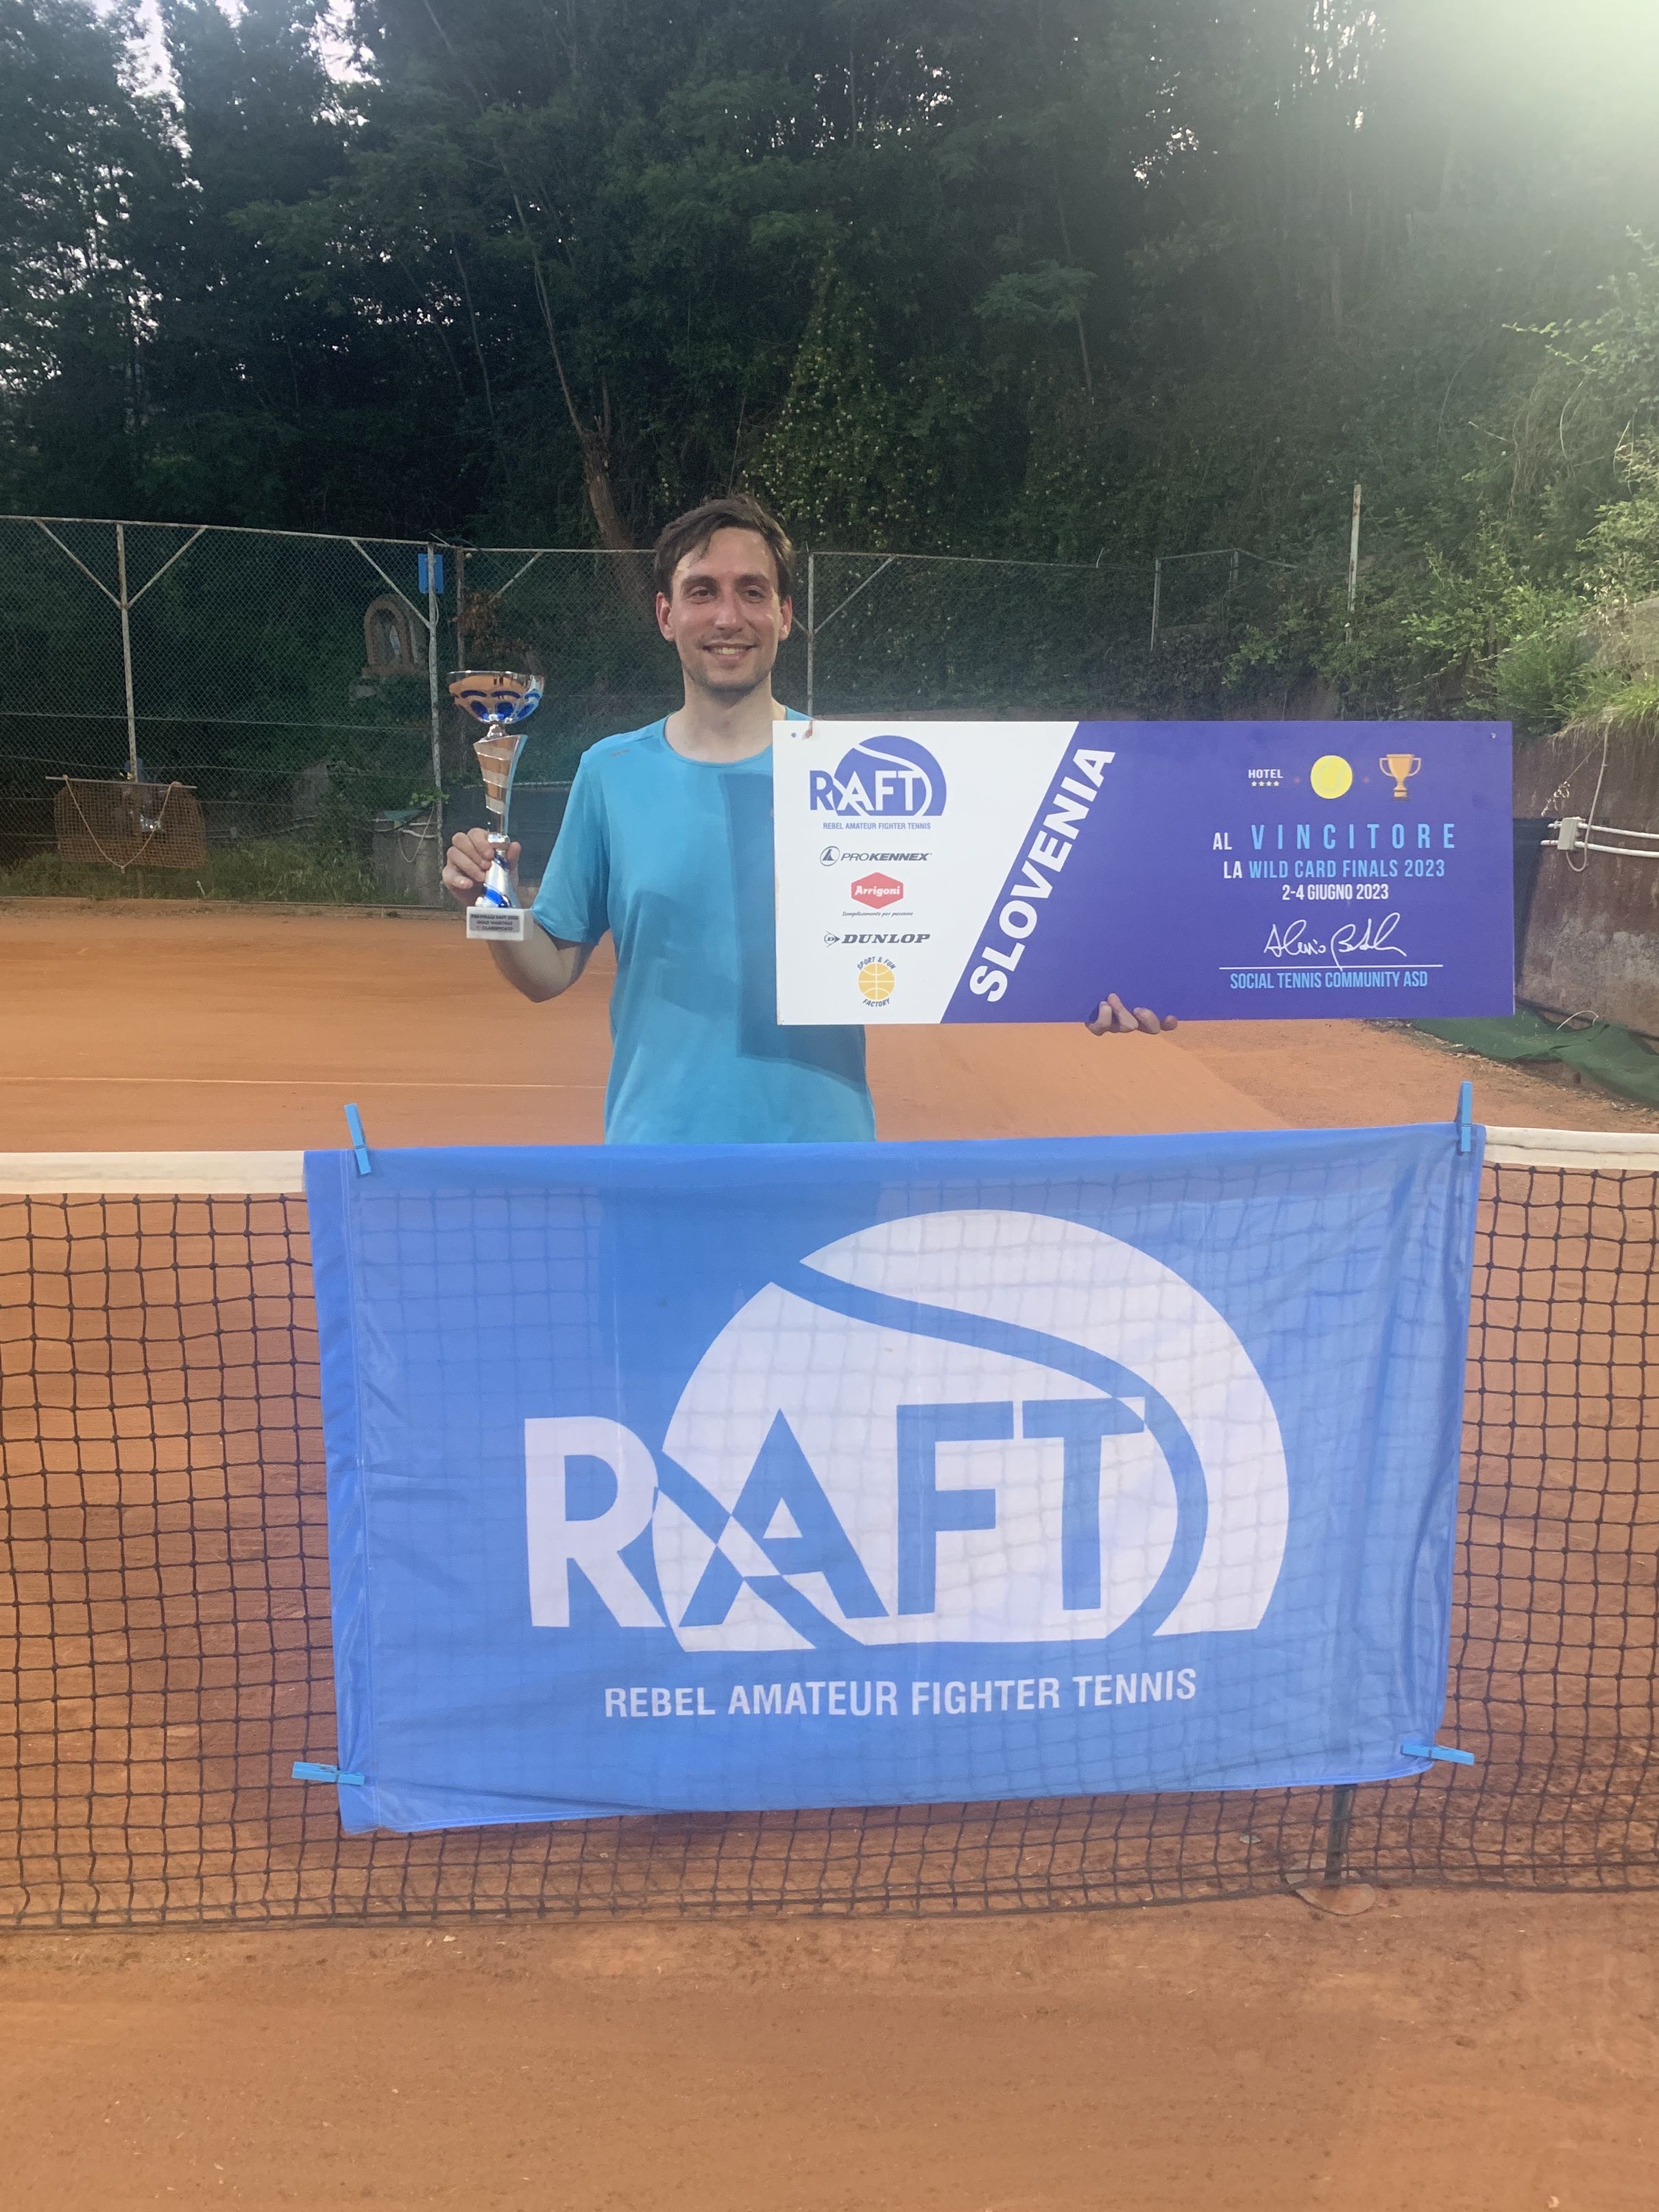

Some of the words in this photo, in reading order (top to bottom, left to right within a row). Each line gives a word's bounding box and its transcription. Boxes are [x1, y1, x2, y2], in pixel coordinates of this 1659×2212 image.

[1248, 769, 1284, 779] HOTEL
[810, 770, 921, 811] RAFT
[1213, 832, 1233, 850] AL
[1250, 824, 1455, 850] VINCITORE
[840, 852, 930, 861] PROKENNEX
[969, 749, 1116, 1002] SLOVENIA
[1223, 861, 1243, 879] LA
[1248, 861, 1288, 878] WILD
[1294, 860, 1336, 878] CARD
[1342, 860, 1398, 878] FINALS
[1404, 859, 1445, 877] 2023
[854, 885, 901, 897] Arrigoni
[1282, 884, 1305, 900] 2-4
[1307, 884, 1353, 900] GIUGNO
[1356, 883, 1389, 900] 2023
[841, 934, 931, 943] DUNLOP
[857, 956, 875, 970] SPORT
[884, 959, 896, 970] FUN
[1230, 972, 1274, 989] SOCIAL
[1276, 972, 1322, 988] TENNIS
[1324, 972, 1400, 988] COMMUNITY
[1403, 971, 1428, 987] ASD
[862, 998, 890, 1007] FACTORY
[524, 1396, 1145, 1628] RAFT
[605, 1687, 716, 1718] REBEL
[728, 1681, 899, 1717] AMATEUR
[912, 1677, 1061, 1715] FIGHTER
[1072, 1668, 1196, 1707] TENNIS
